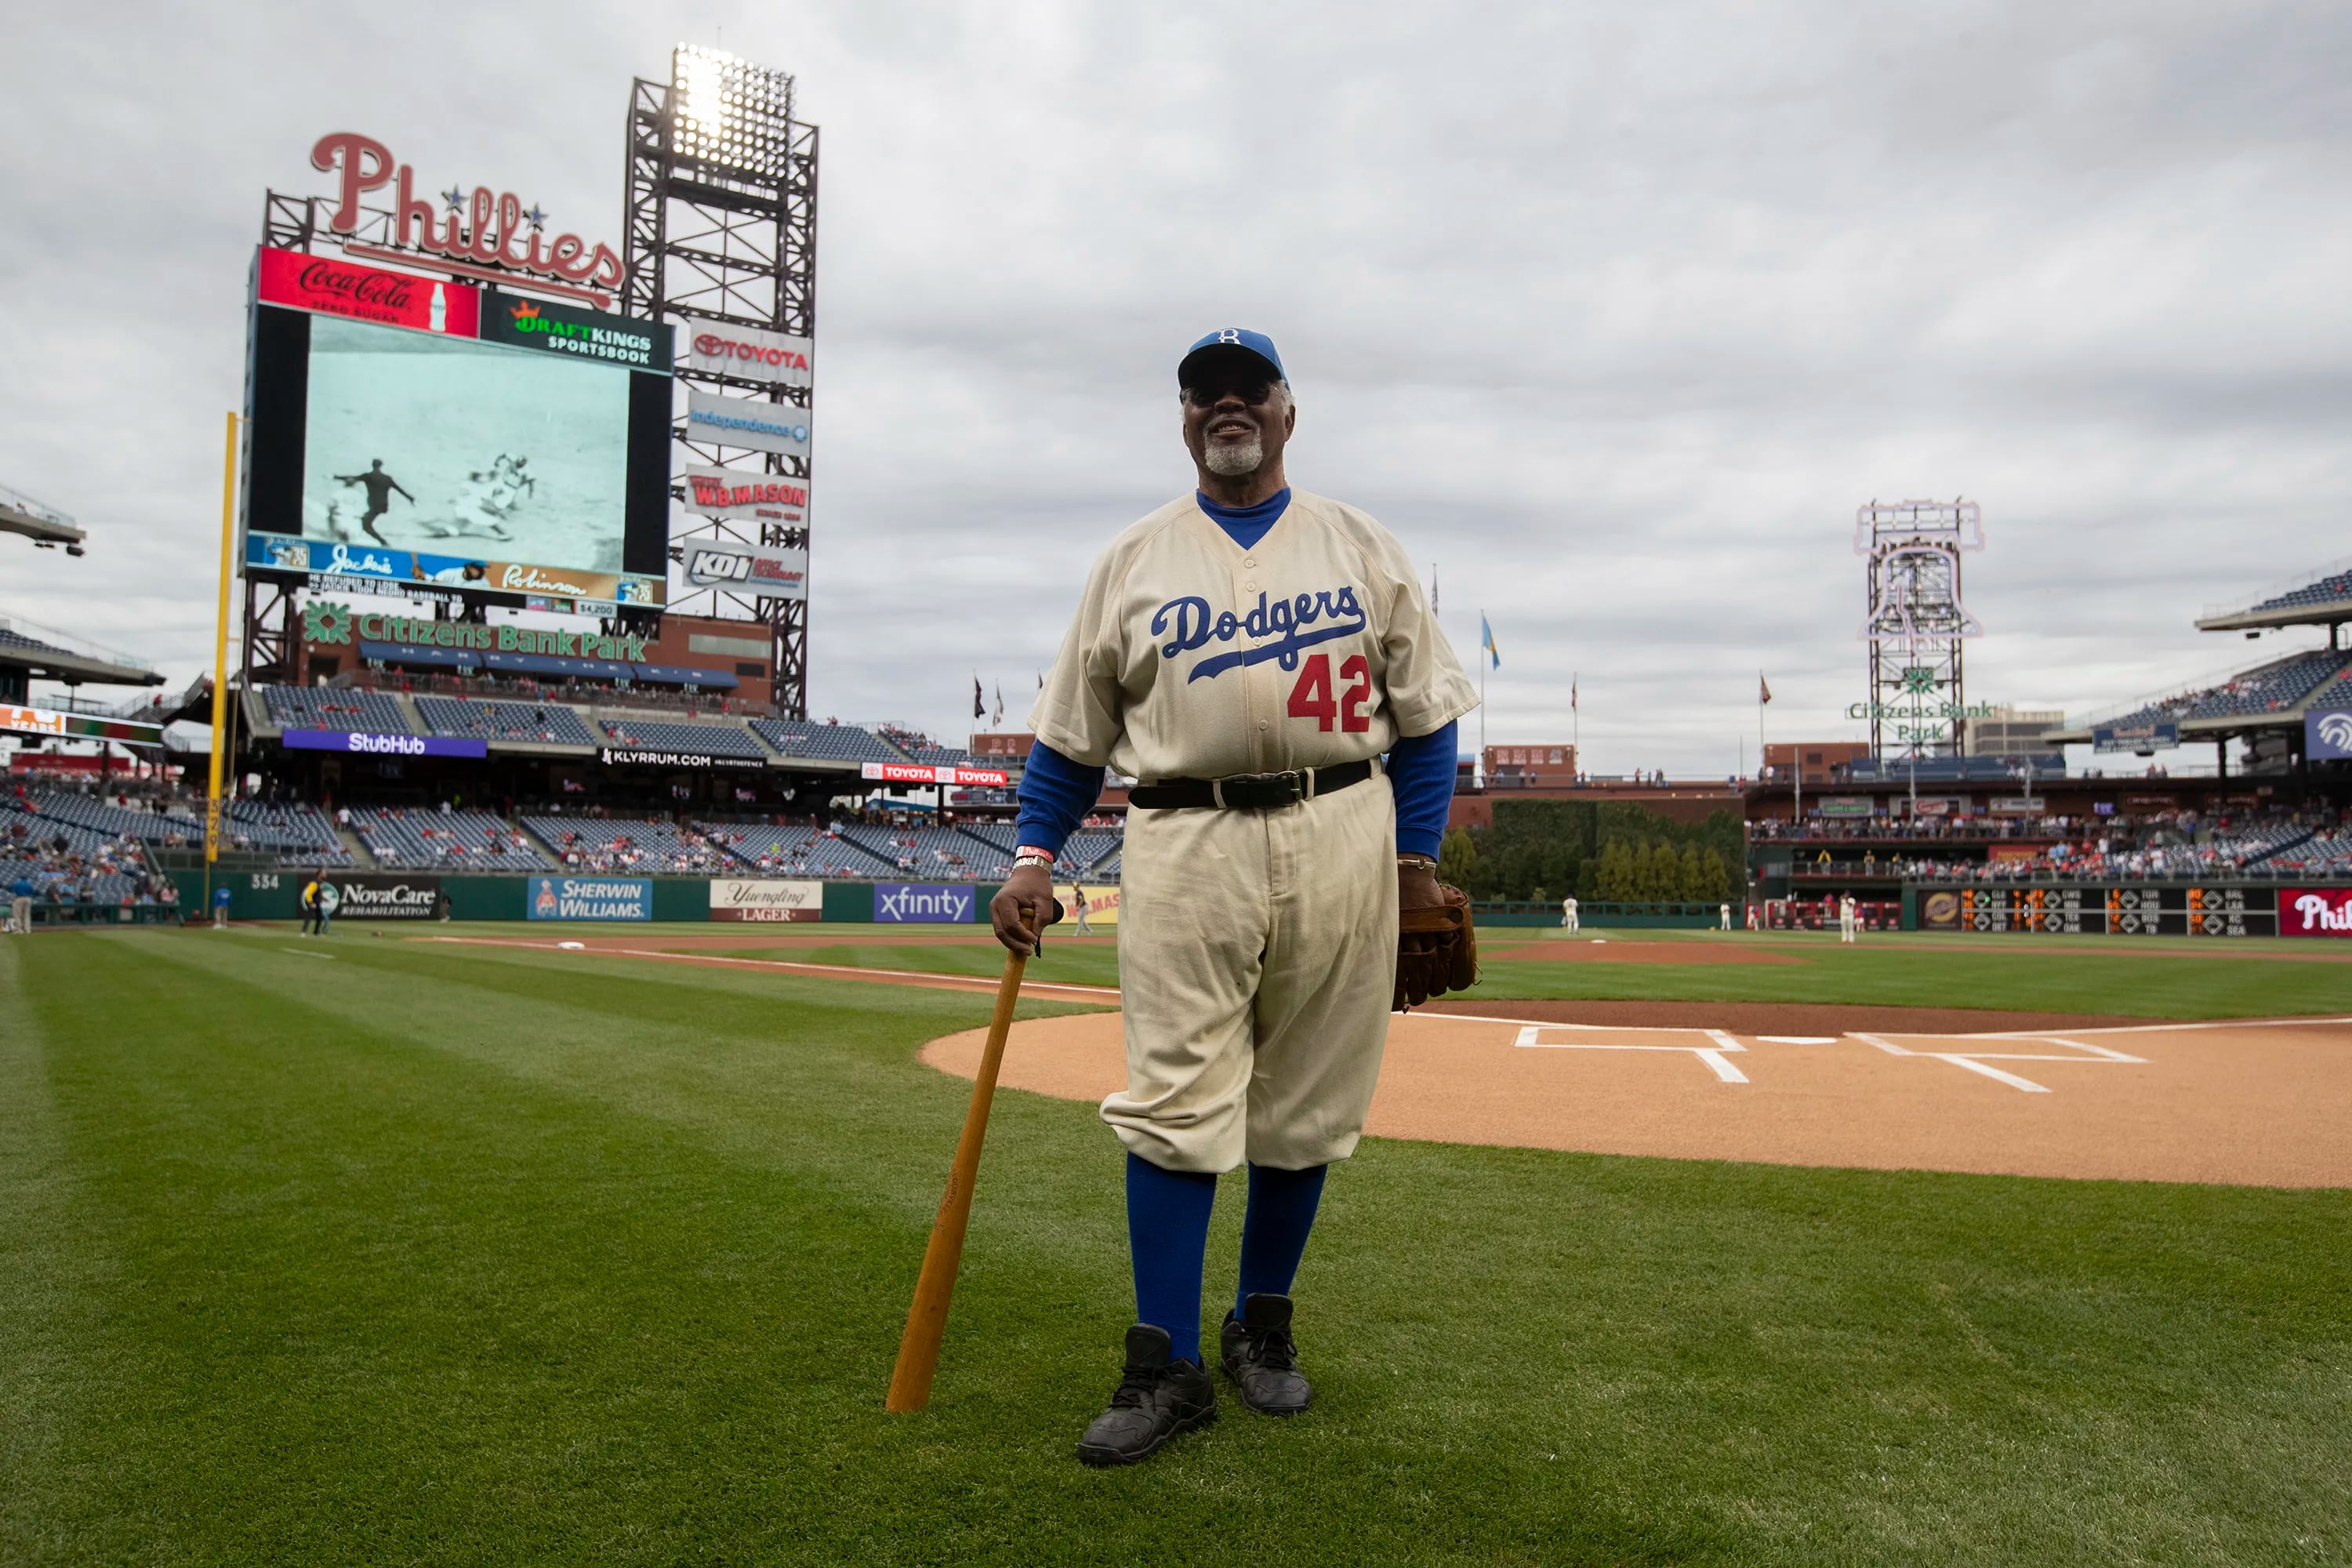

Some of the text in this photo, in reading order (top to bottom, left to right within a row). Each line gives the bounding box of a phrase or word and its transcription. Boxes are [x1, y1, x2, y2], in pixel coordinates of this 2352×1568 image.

[311, 132, 626, 290] Phillies
[299, 261, 412, 310] Coca-Cola
[311, 301, 398, 324] ZERO SUGAR
[514, 315, 652, 351] DRAFTKINGS
[547, 336, 650, 365] SPORTSBOOK
[723, 340, 809, 371] TOYOTA
[326, 543, 393, 574] Jackie
[691, 550, 753, 583] KDI
[502, 564, 587, 596] Robinson
[321, 583, 350, 593] JACKIE
[352, 586, 375, 597] TOOK
[376, 587, 406, 598] NEGRO
[407, 590, 450, 603] BASEBALL
[452, 593, 463, 604] TO
[359, 612, 647, 662] Citizens Bank Park
[1151, 586, 1366, 673] Dodgers
[1287, 653, 1371, 733] 42
[1849, 699, 1992, 720] Citizens Bank
[348, 732, 426, 755] StubHub
[1897, 723, 1944, 741] Park
[613, 750, 711, 768] KLYRRUM.COM
[884, 766, 1004, 783] TOYOTA TOYOTA
[251, 873, 280, 890] 334
[560, 879, 642, 899] SHERWIN
[340, 883, 437, 905] NovaCare
[724, 882, 808, 906] Yuengling
[880, 887, 970, 922] xfinity
[2063, 900, 2081, 910] MIN
[339, 906, 432, 916] REHABILITATION
[742, 908, 792, 921] LAGER
